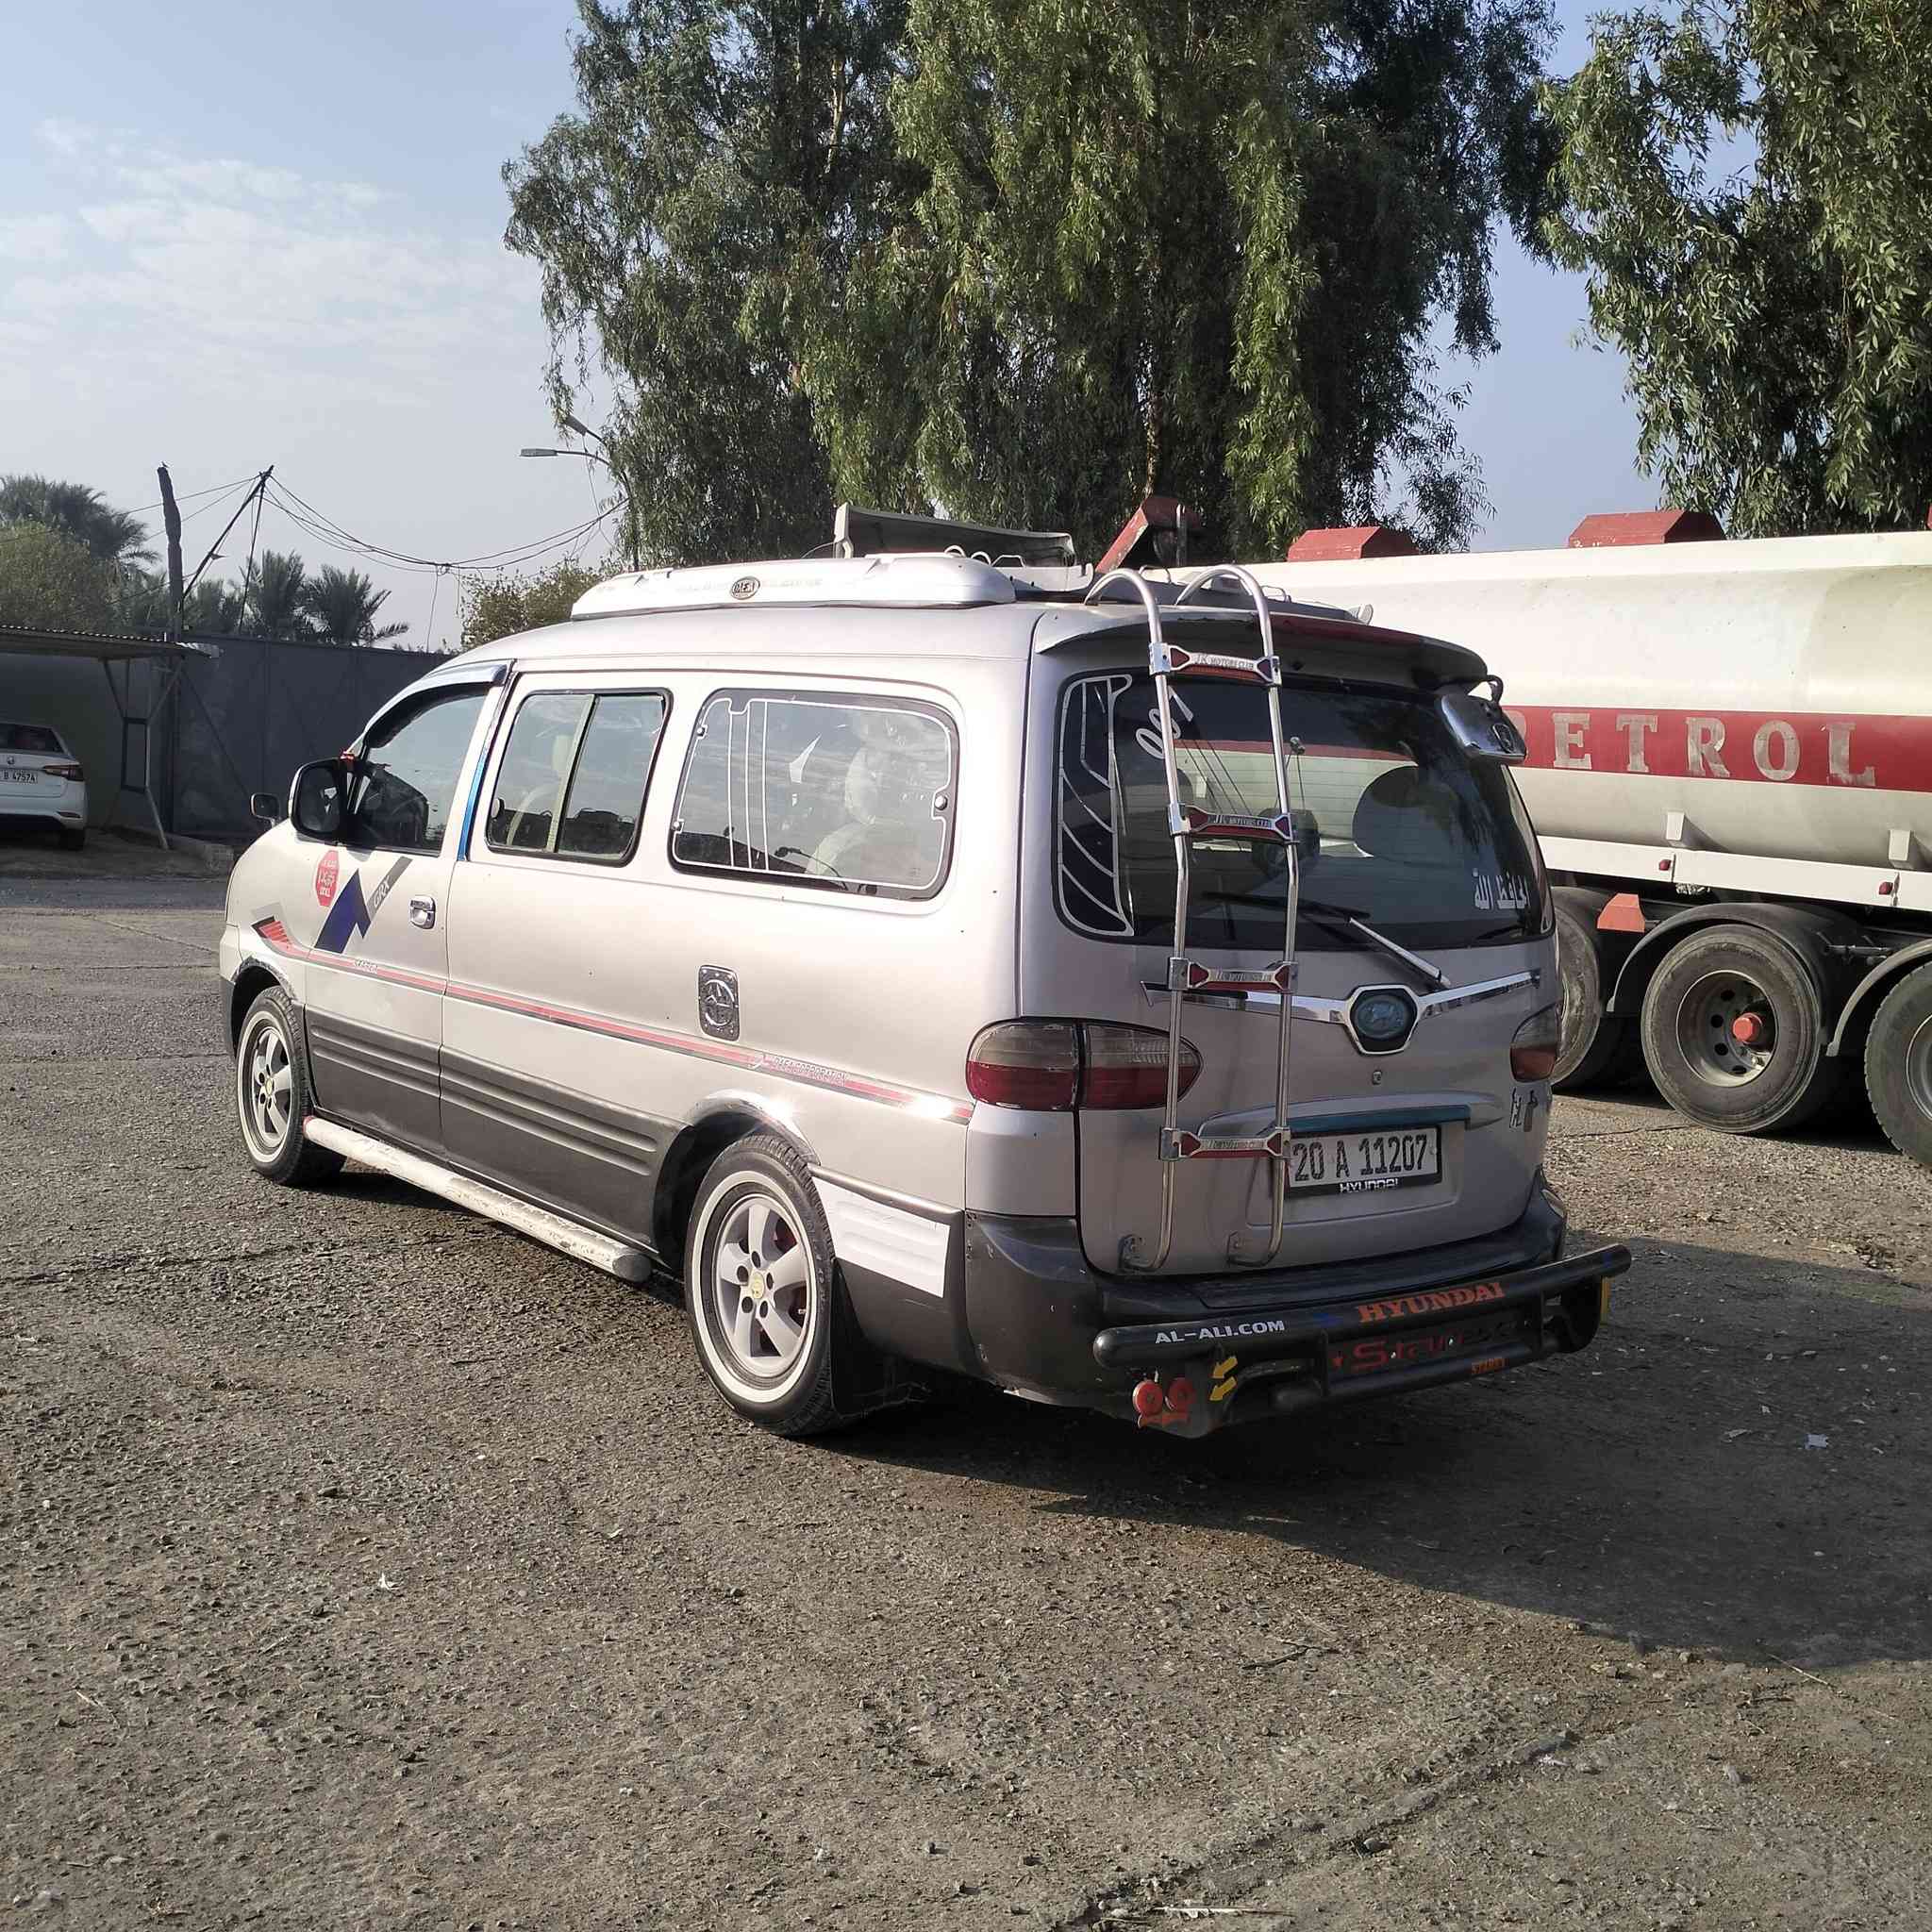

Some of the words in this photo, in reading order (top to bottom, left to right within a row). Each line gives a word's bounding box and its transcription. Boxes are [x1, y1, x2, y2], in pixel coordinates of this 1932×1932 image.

[1292, 1141, 1324, 1181] 20
[1336, 1140, 1350, 1178] A
[1358, 1134, 1427, 1177] 11207
[1340, 1178, 1400, 1194] HYUNDAI
[1356, 1282, 1507, 1323] HYUNDAI
[1155, 1320, 1286, 1344] AL-ALI.COM
